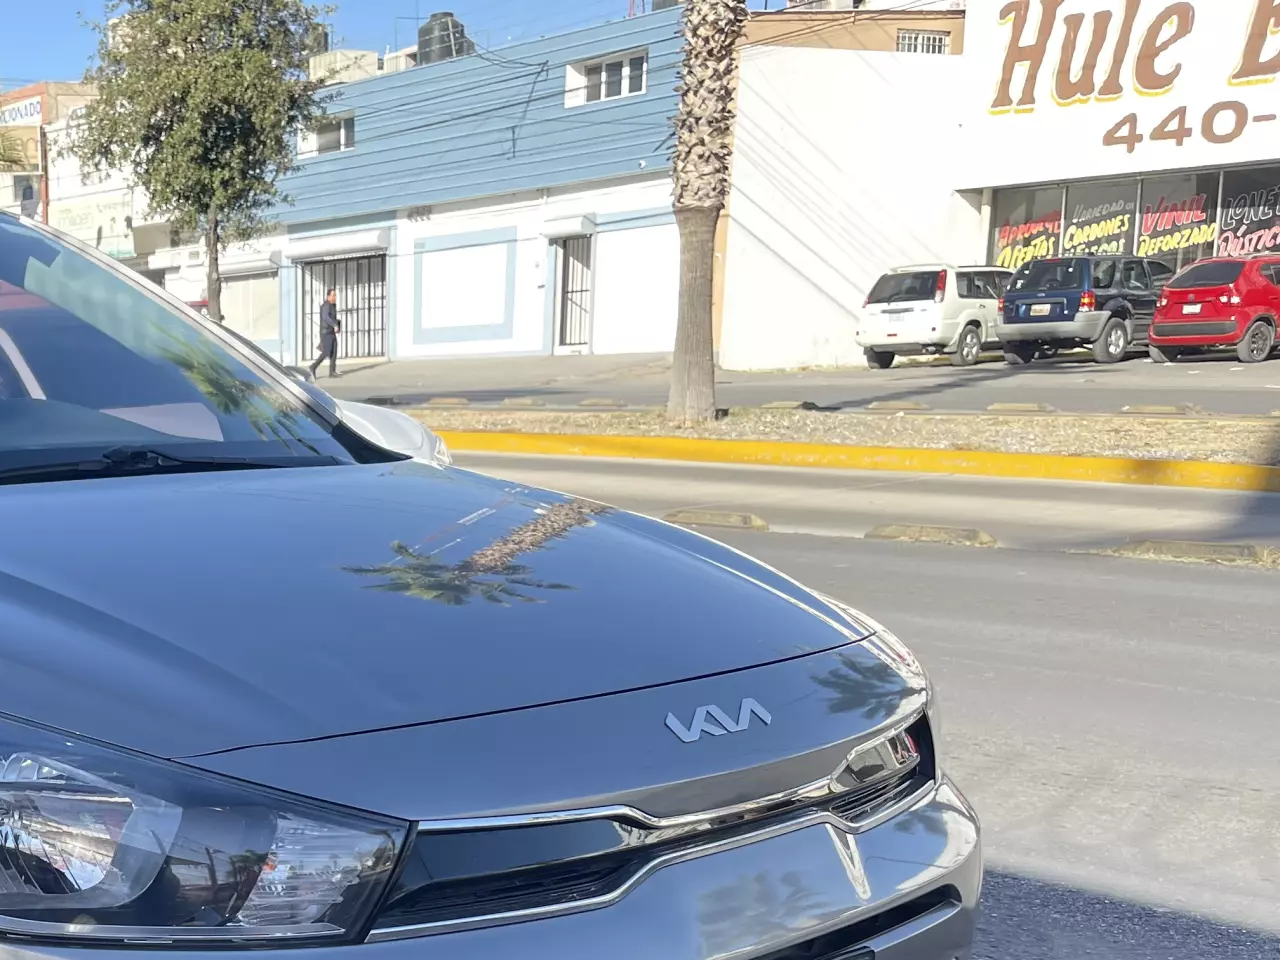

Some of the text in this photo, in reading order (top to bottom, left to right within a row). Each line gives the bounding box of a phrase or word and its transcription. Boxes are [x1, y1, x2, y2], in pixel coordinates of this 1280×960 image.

[988, 0, 1195, 113] Hule
[1102, 100, 1280, 154] 440-
[1063, 213, 1131, 250] CORDONES
[1141, 192, 1208, 236] VINIL
[1138, 222, 1218, 258] REFORZADO
[664, 697, 772, 743] KIA
